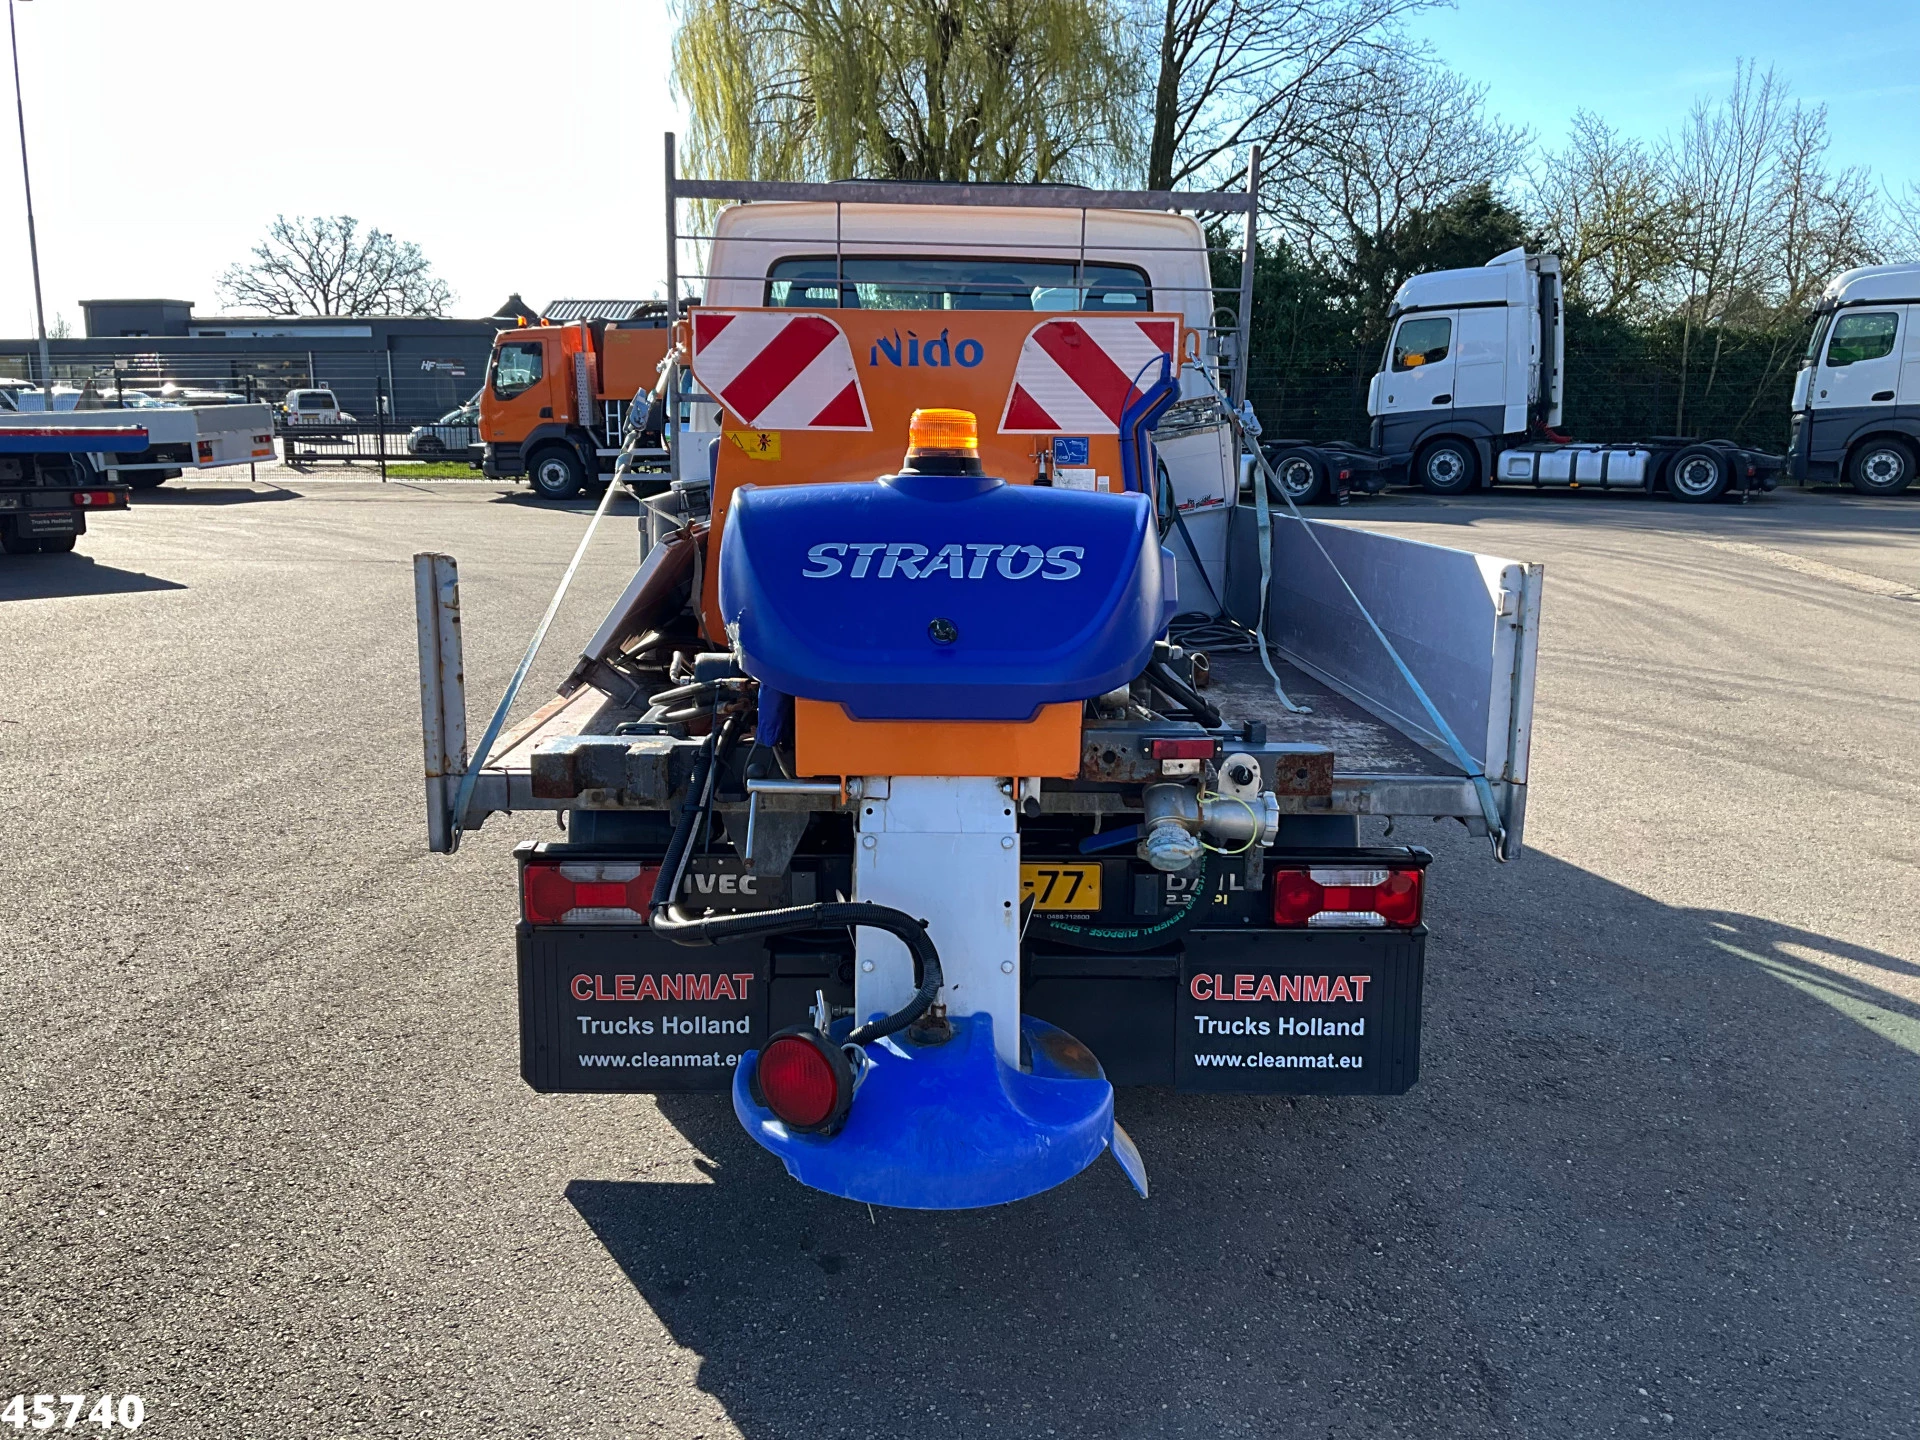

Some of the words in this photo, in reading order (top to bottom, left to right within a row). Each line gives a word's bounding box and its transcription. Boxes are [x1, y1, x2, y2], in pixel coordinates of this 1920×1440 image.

[869, 327, 985, 368] Nido
[802, 542, 1085, 580] STRATOS
[1050, 920, 1081, 934] EPDM
[1088, 928, 1139, 939] PURPOSE
[1143, 910, 1186, 936] GENERAL
[570, 972, 755, 1001] CLEANMAT
[1189, 974, 1371, 1003] CLEANMAT
[577, 1016, 654, 1035] Trucks
[662, 1015, 750, 1035] Holland
[1195, 1016, 1271, 1036] Trucks
[1278, 1017, 1365, 1037] Holland
[578, 1051, 742, 1068] www.cleanmat.e
[1194, 1051, 1363, 1069] www.cleanmat.eu
